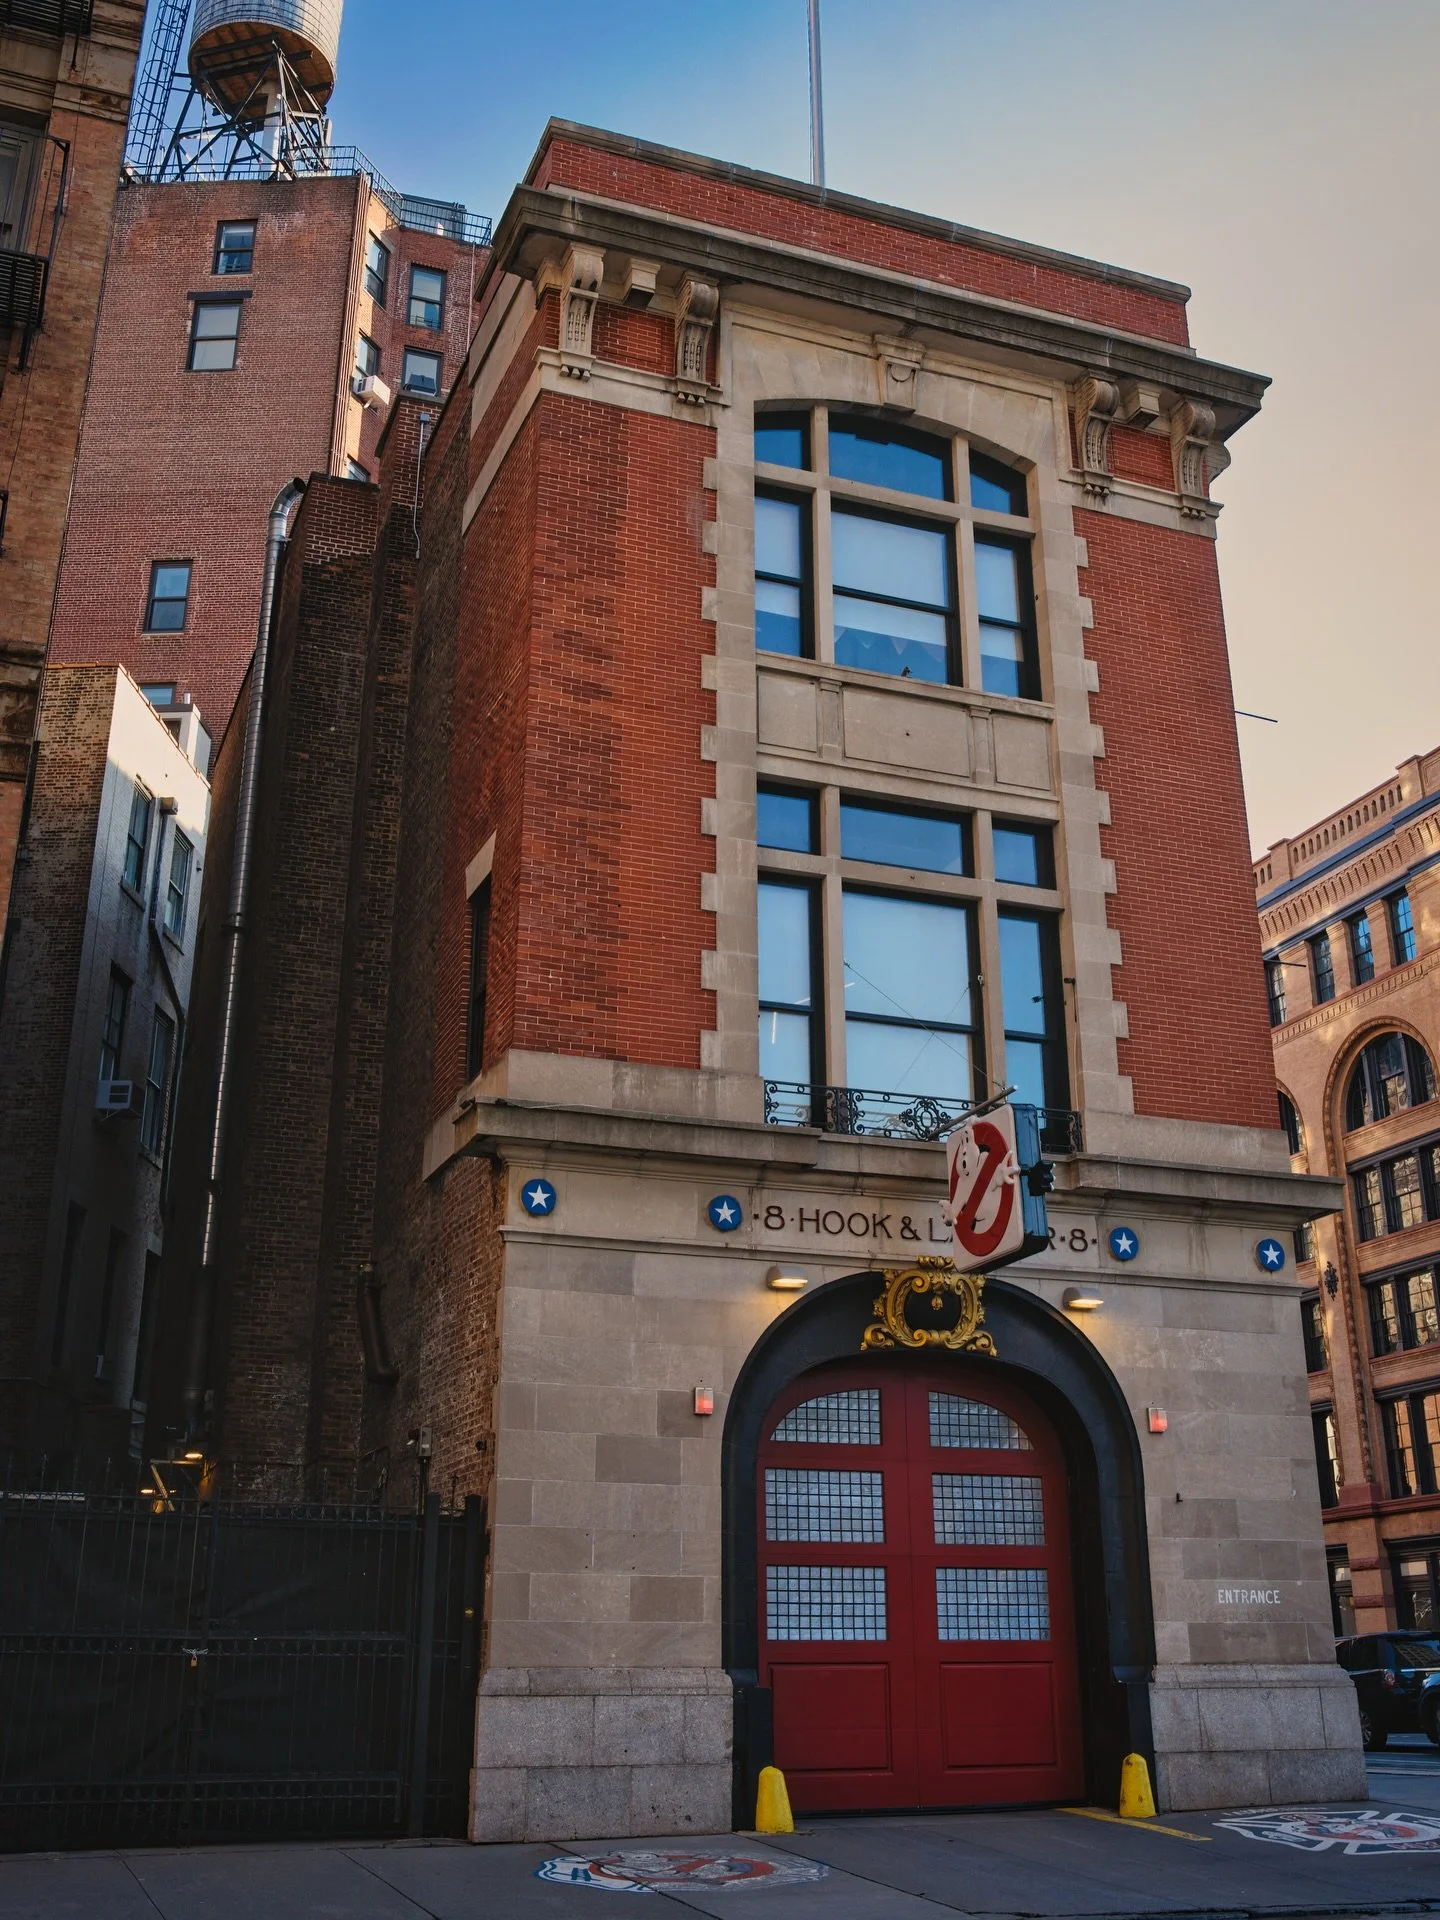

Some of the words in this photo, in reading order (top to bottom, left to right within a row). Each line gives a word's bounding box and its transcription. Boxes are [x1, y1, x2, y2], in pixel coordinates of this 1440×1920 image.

[799, 1207, 893, 1239] HOOK
[900, 1216, 922, 1241] &
[1217, 1588, 1281, 1604] ENTRANCE
